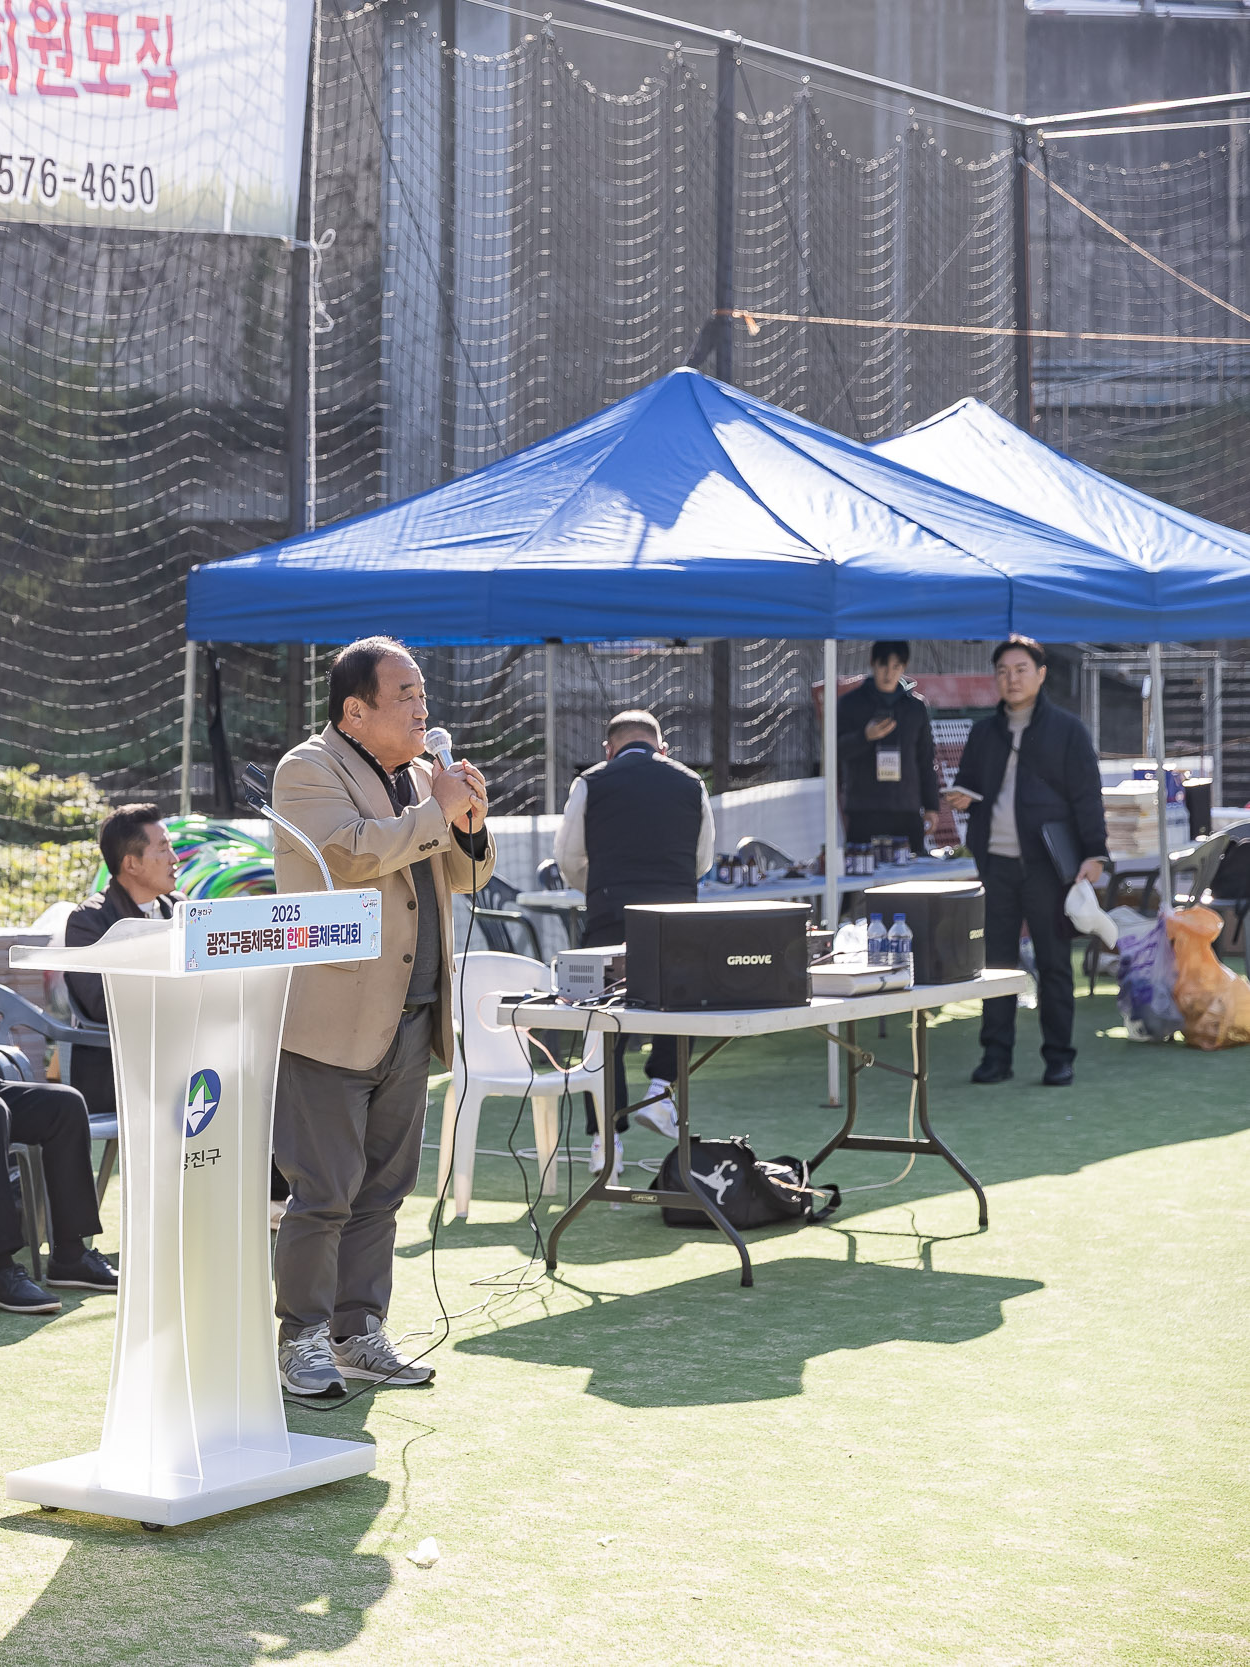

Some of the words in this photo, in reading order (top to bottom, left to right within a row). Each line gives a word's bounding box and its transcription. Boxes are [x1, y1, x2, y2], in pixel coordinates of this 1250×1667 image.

[271, 904, 301, 923] 2025
[206, 928, 285, 956] 광진구동체육회
[286, 922, 362, 950] 한마음체육대회
[726, 954, 772, 966] GROOVE
